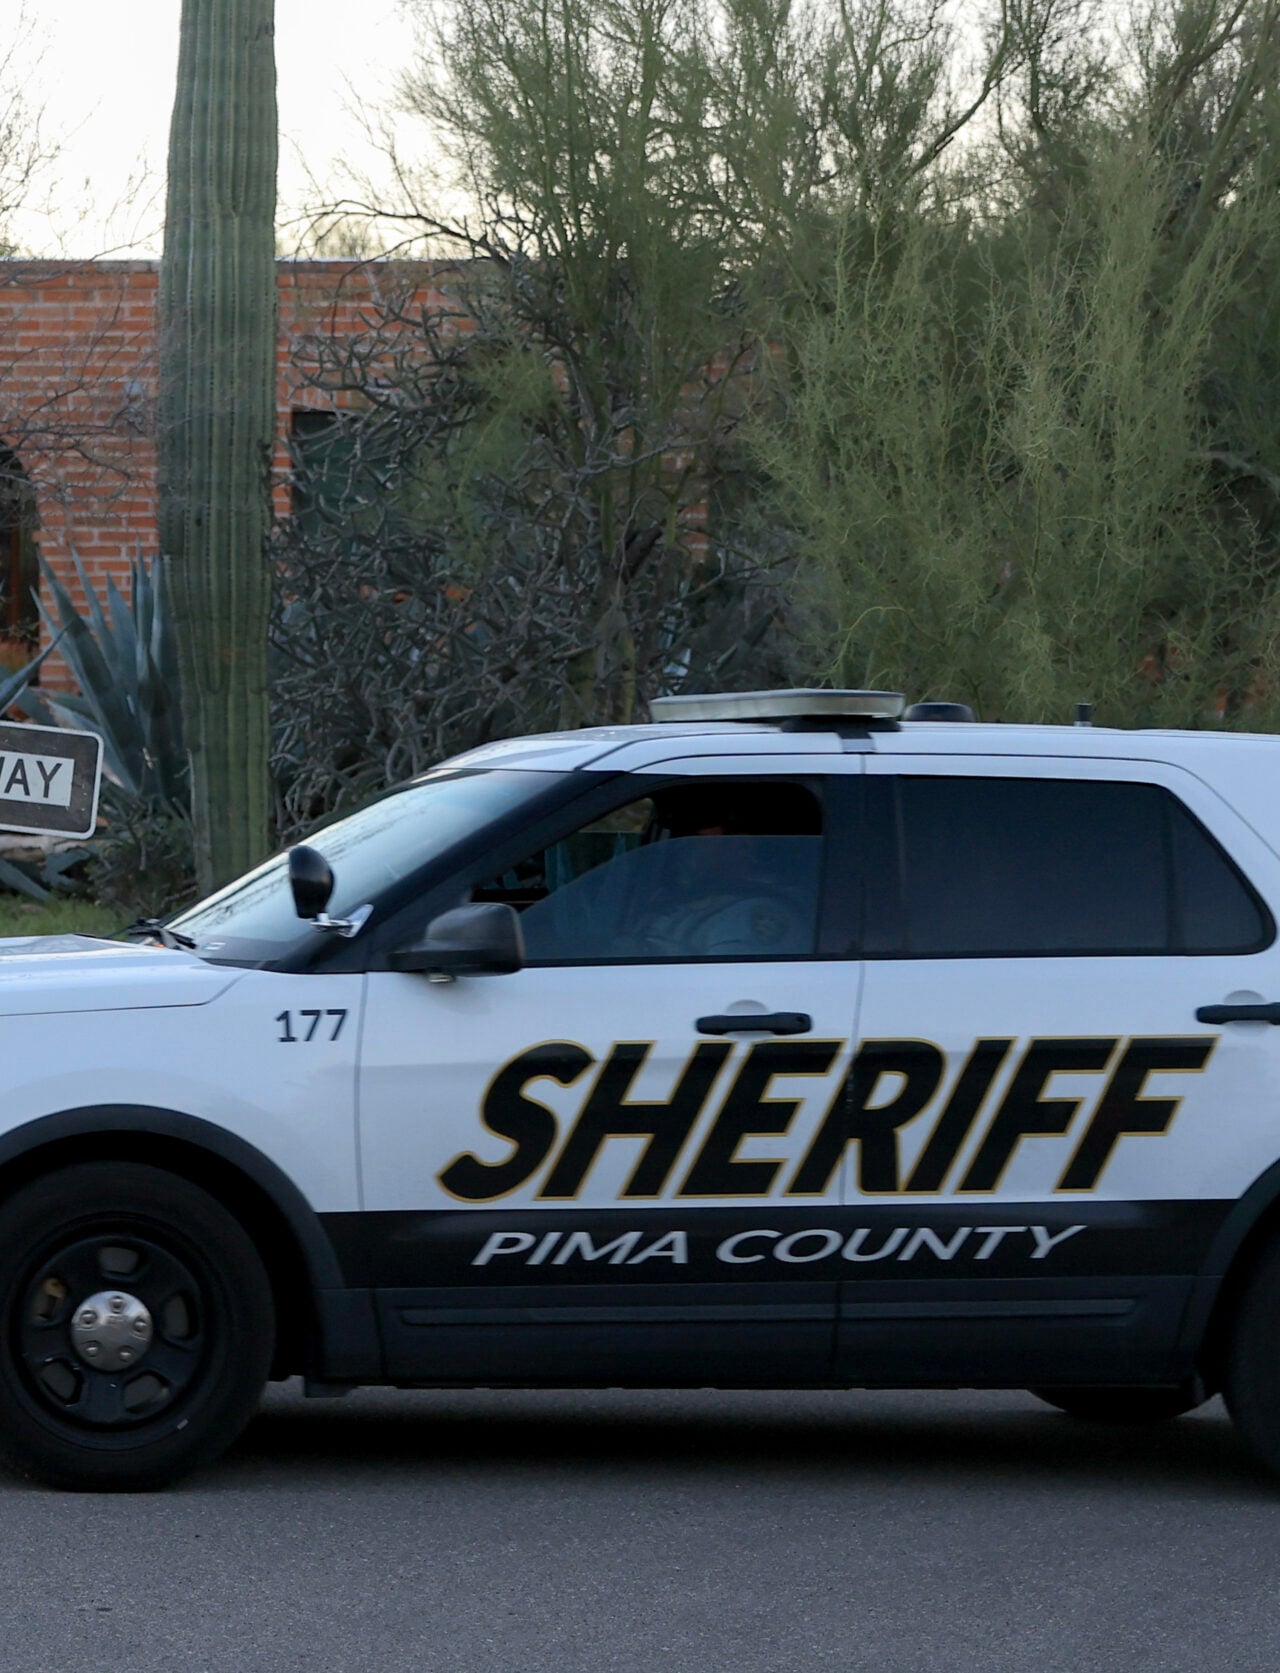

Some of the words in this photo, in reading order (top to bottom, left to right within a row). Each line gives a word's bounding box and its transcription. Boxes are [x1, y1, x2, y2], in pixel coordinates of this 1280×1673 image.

[276, 1009, 347, 1042] 177
[436, 1034, 1220, 1202] SHERIFF
[472, 1230, 689, 1266] PIMA
[716, 1225, 1087, 1263] COUNTY
